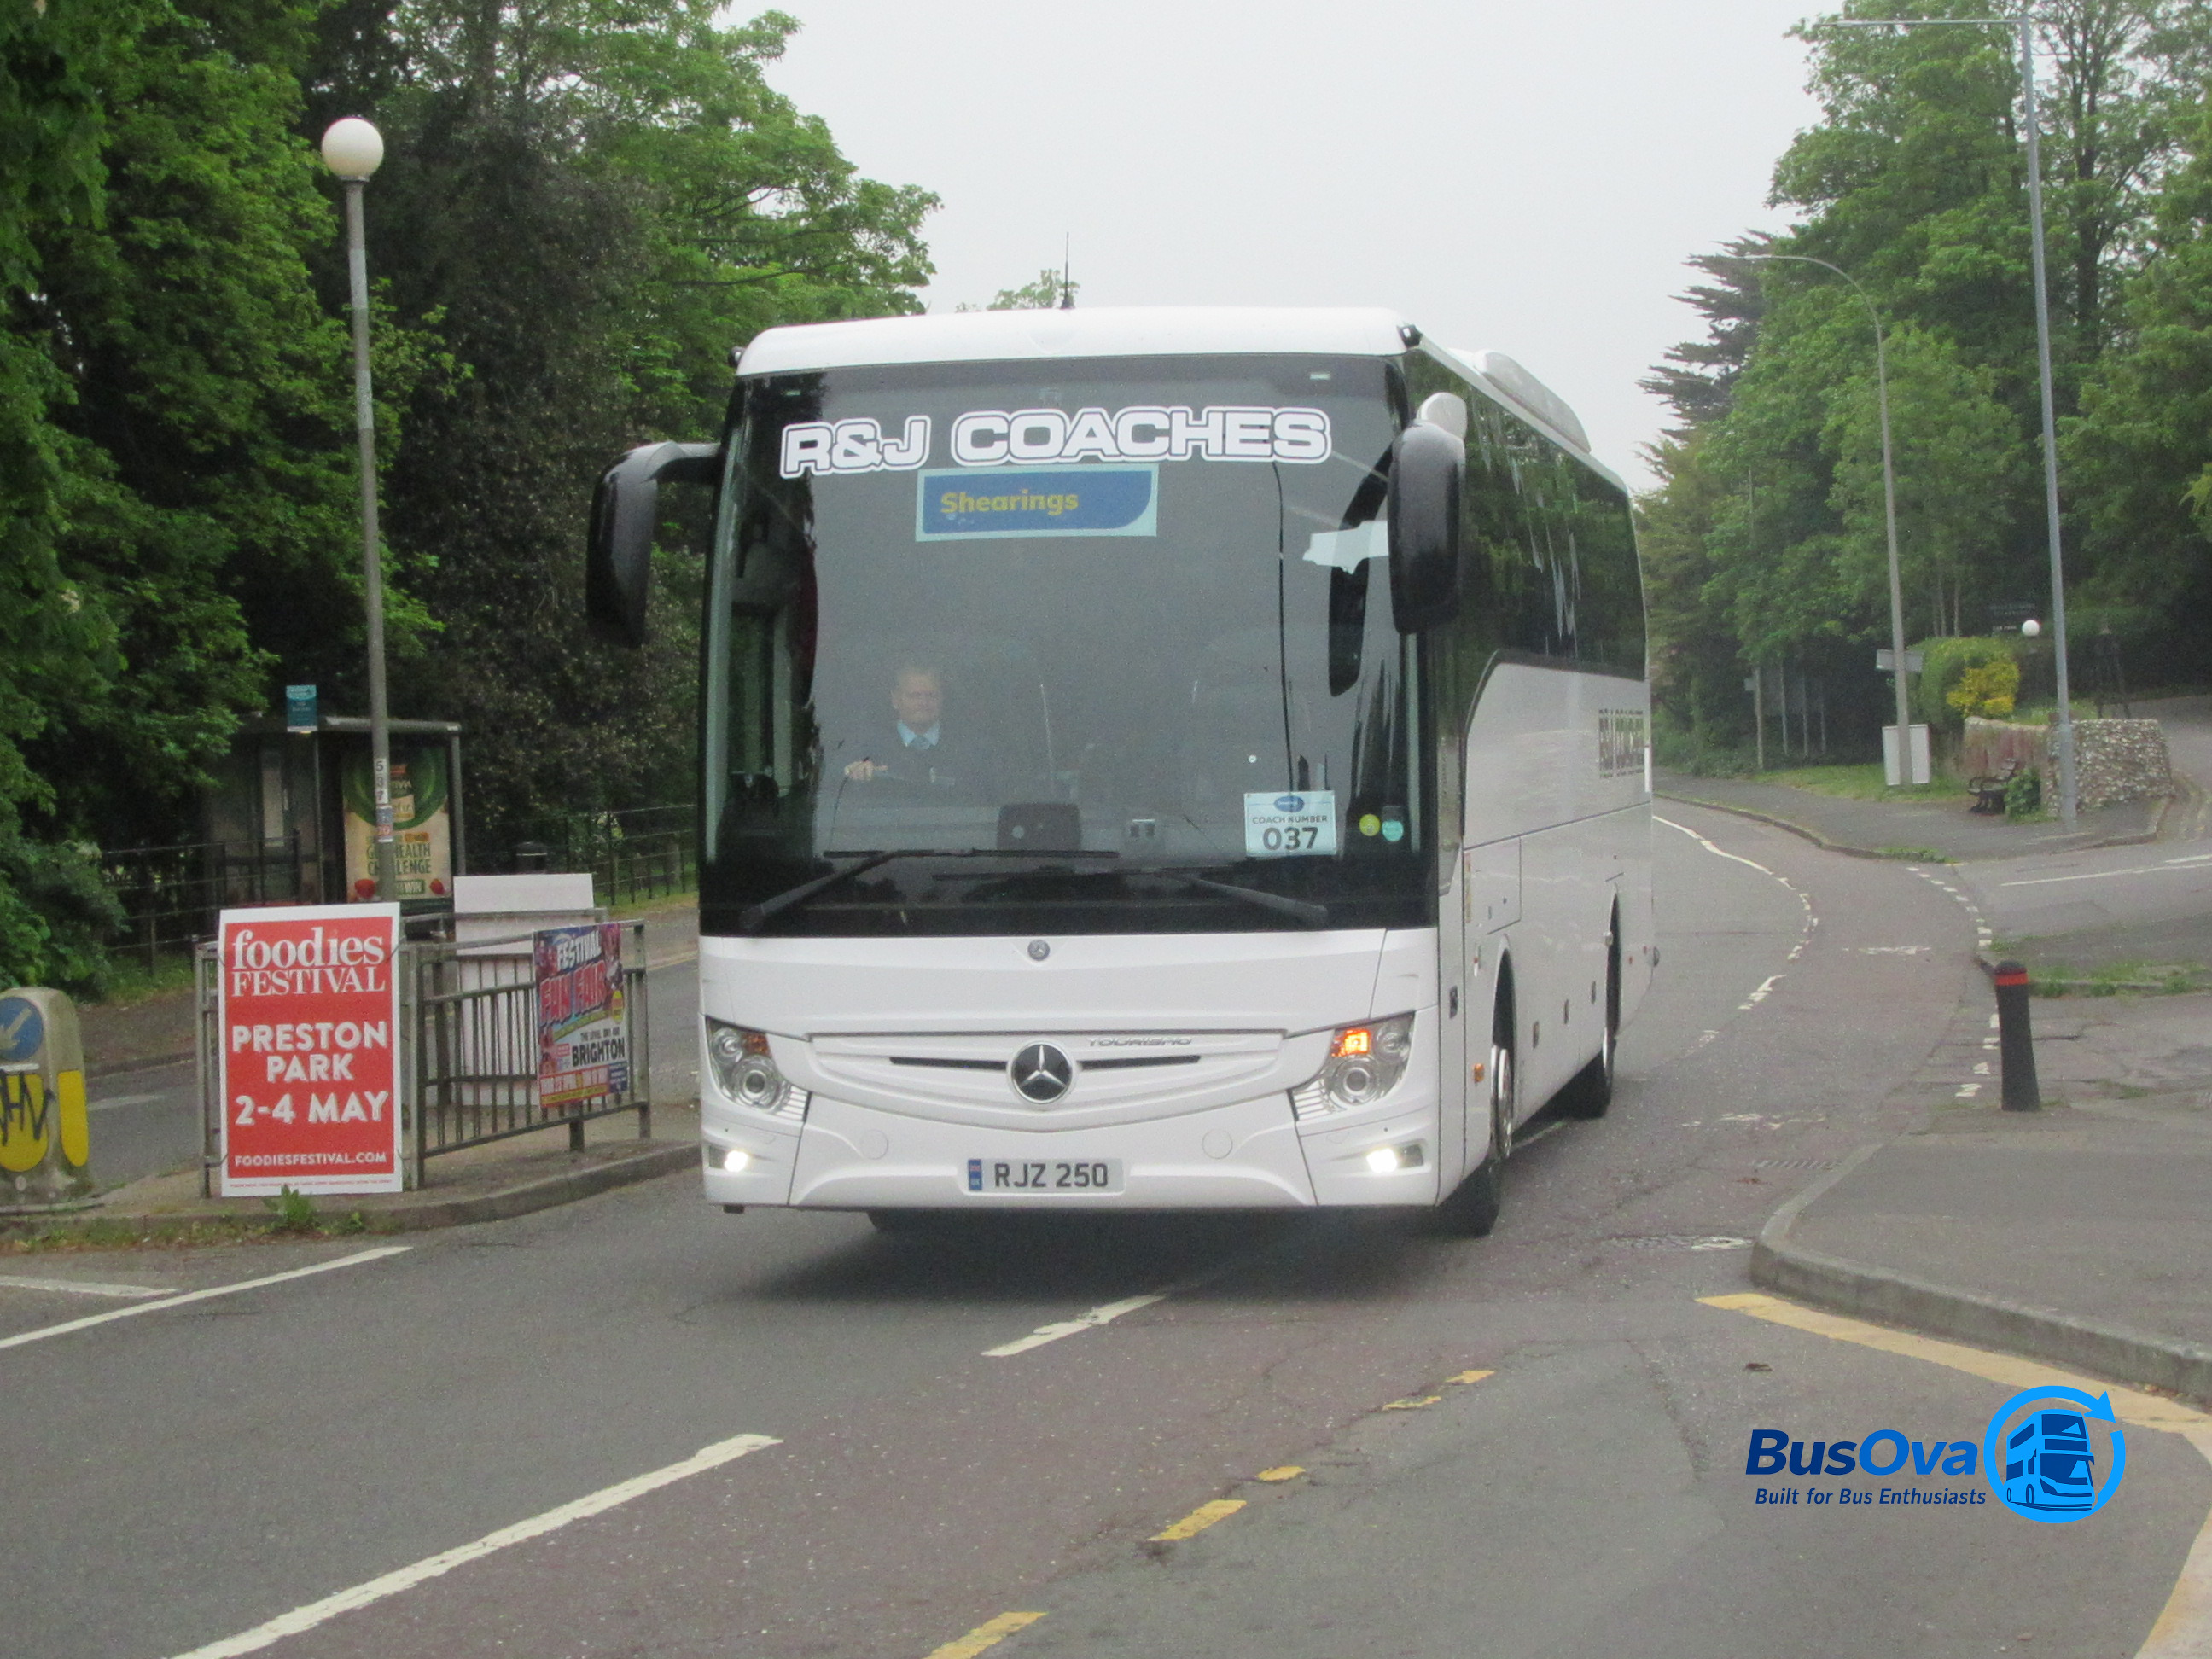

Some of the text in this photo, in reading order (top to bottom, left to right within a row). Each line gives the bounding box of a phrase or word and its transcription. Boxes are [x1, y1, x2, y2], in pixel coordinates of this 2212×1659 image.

[780, 406, 1331, 480] R&J COACHES
[940, 489, 1079, 516] Shearings
[1252, 814, 1328, 824] COACH NUMBER
[1262, 826, 1318, 851] 037
[232, 927, 385, 970] foodies
[231, 966, 386, 998] FESTIVAL
[232, 1021, 387, 1053] PRESTON
[572, 1036, 626, 1068] BRIGHTON
[266, 1053, 354, 1083] PARK
[235, 1090, 389, 1126] 2-4 MAY
[235, 1152, 387, 1167] FOODIESFESTIVAL.COM
[993, 1162, 1109, 1188] RJZ 250
